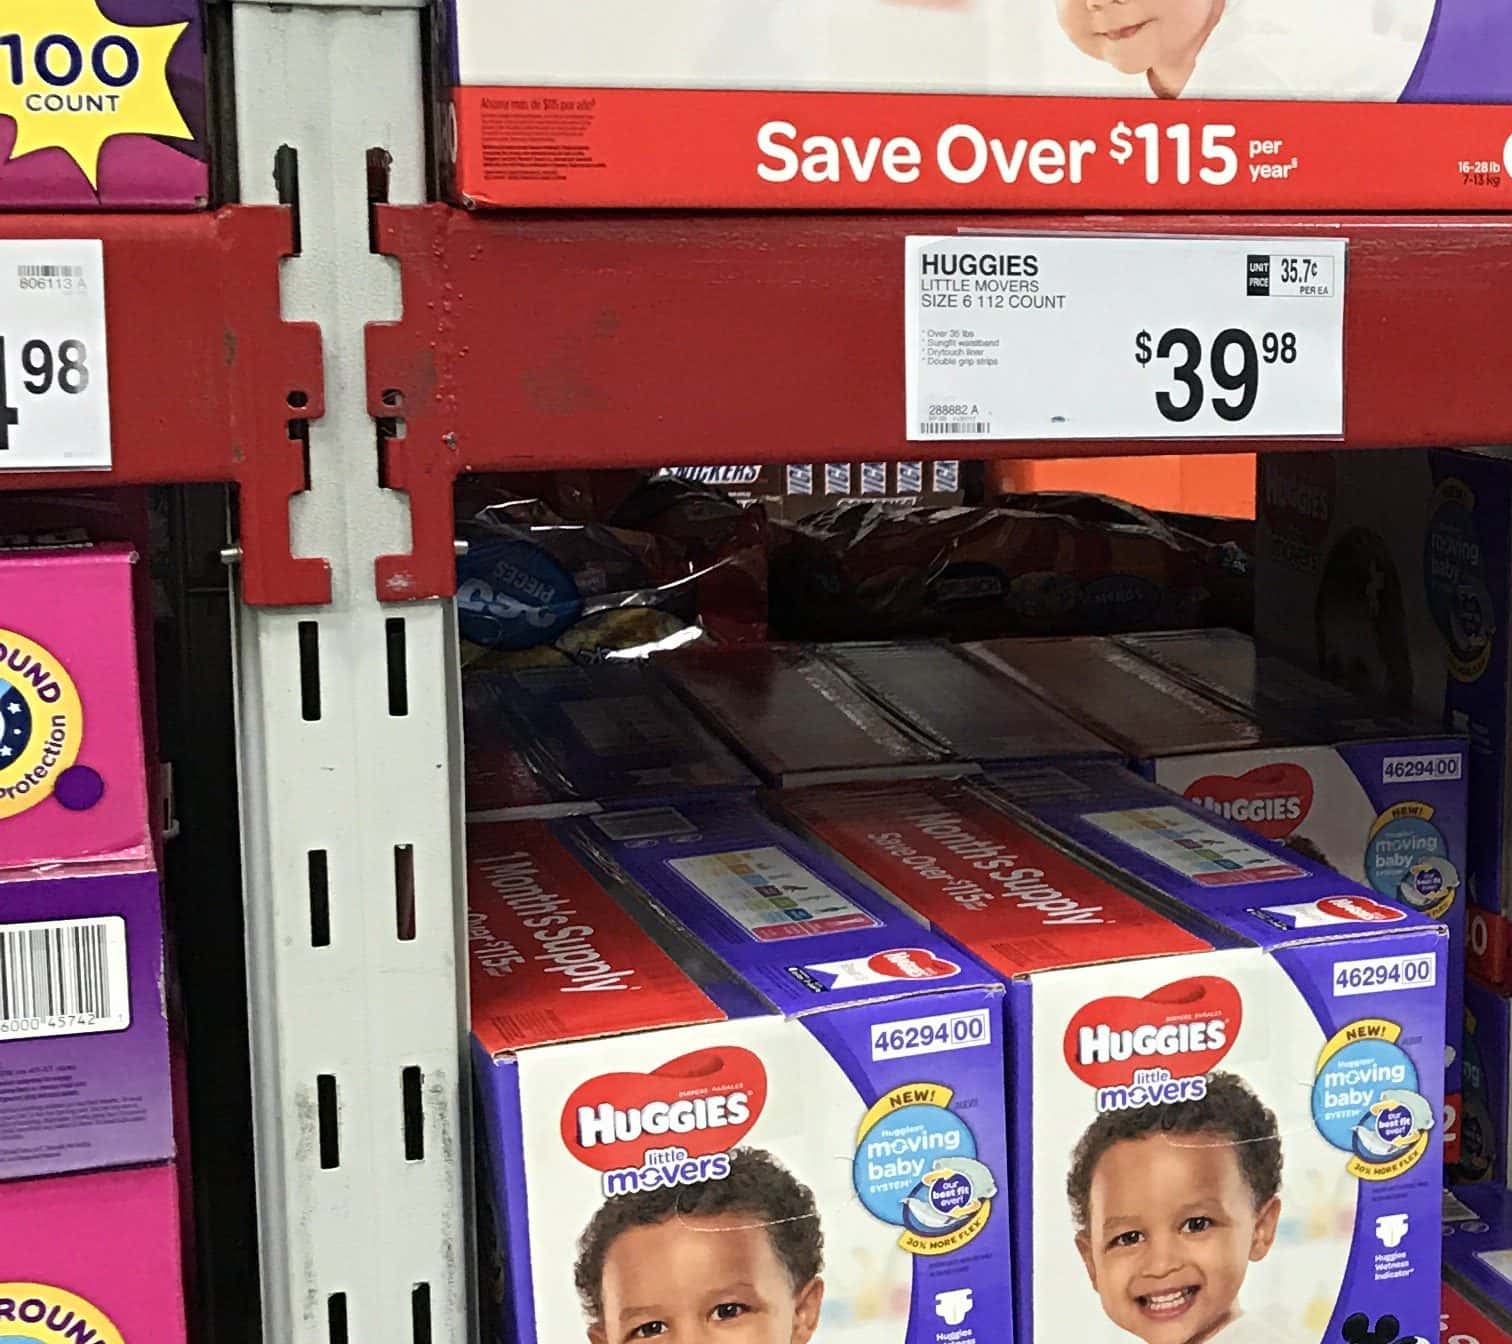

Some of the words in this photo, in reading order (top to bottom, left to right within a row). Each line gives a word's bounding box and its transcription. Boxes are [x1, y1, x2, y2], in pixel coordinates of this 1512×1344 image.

[0, 34, 140, 87] 100
[25, 93, 120, 113] COUNT
[755, 120, 921, 185] Save
[936, 123, 1096, 185] Over
[1108, 120, 1239, 186] $115
[1248, 136, 1283, 158] per
[920, 252, 1039, 278] HUGGIES
[1249, 261, 1270, 274] UNIT
[920, 279, 972, 293] LITTLE
[973, 280, 1041, 293] MOVERS
[1249, 276, 1270, 289] PRICE
[1299, 285, 1317, 296] PER
[1317, 285, 1330, 296] EA
[920, 293, 959, 309] SIZE
[961, 293, 974, 309] 6
[977, 293, 1005, 309] 112
[1007, 294, 1067, 309] COUNT
[1078, 1018, 1228, 1066] HUGGIES
[889, 1088, 937, 1108] NEW!
[578, 1090, 752, 1149] HUGGIES
[867, 1127, 962, 1159] moving
[605, 1154, 730, 1197] movers
